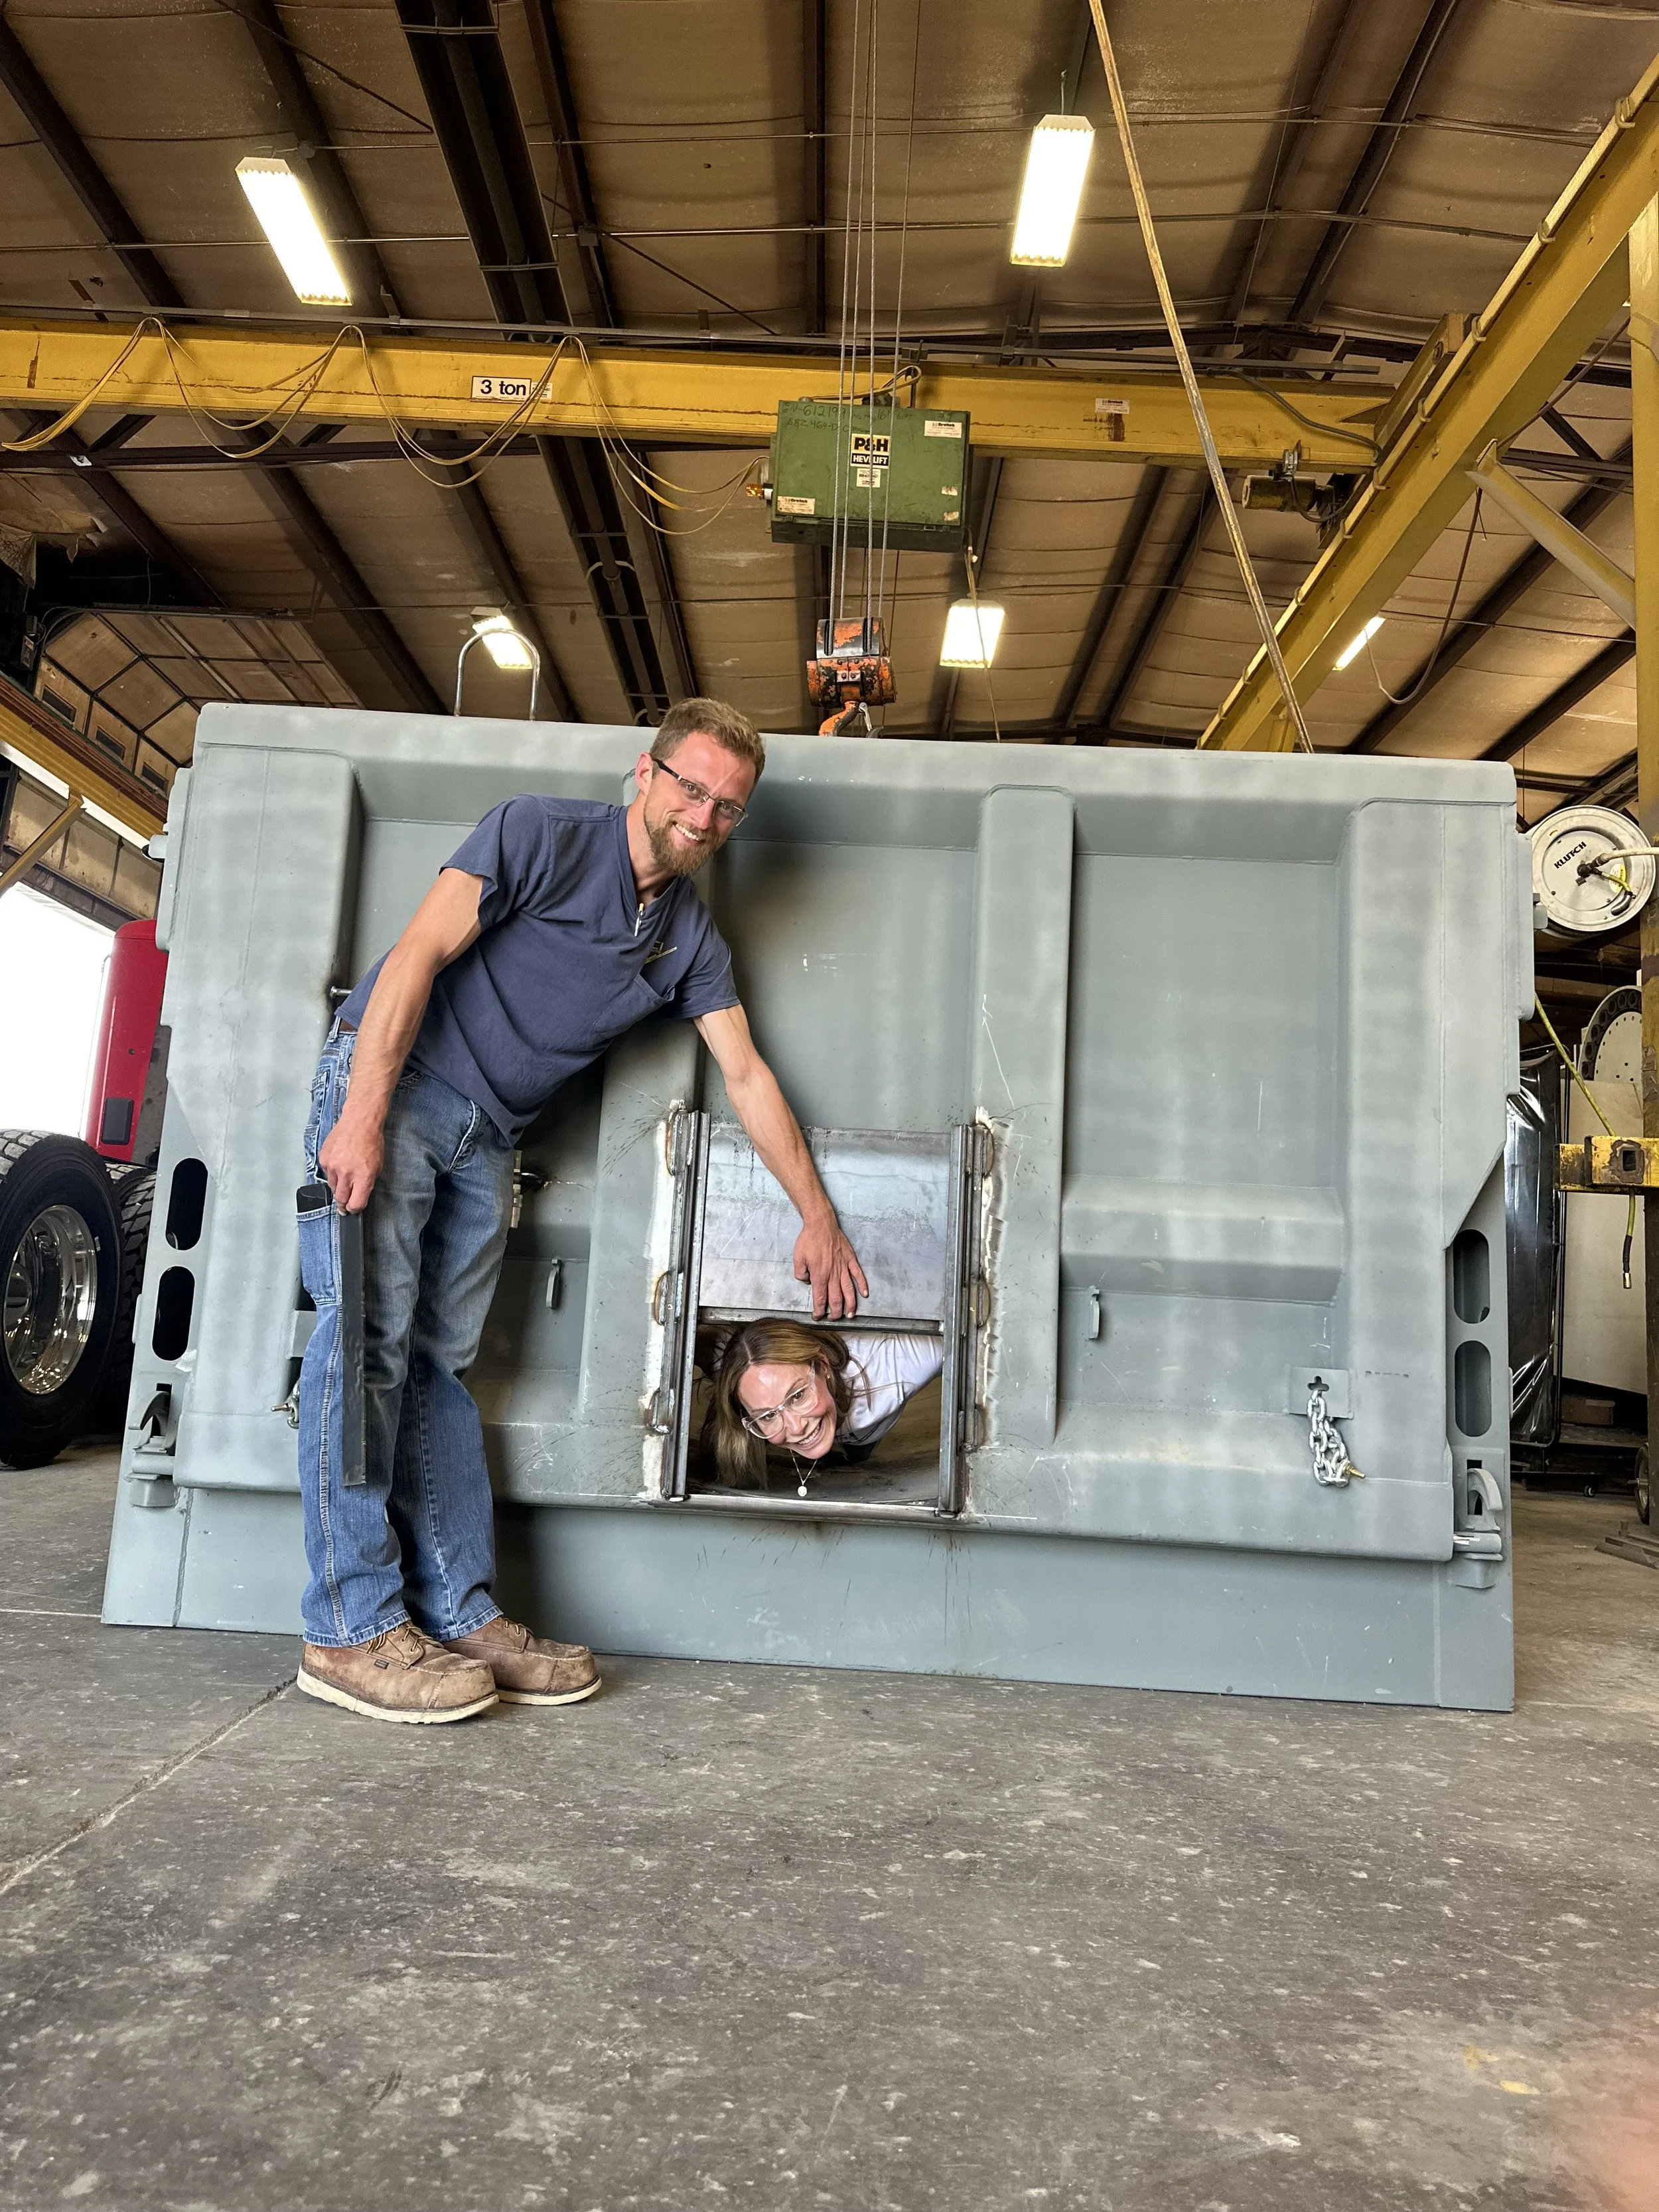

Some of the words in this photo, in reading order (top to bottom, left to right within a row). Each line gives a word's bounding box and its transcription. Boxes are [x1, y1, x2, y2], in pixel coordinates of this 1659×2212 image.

[480, 379, 492, 394] 3
[499, 380, 526, 396] ton
[854, 437, 889, 452] P&H
[1553, 841, 1587, 869] KLUTCH
